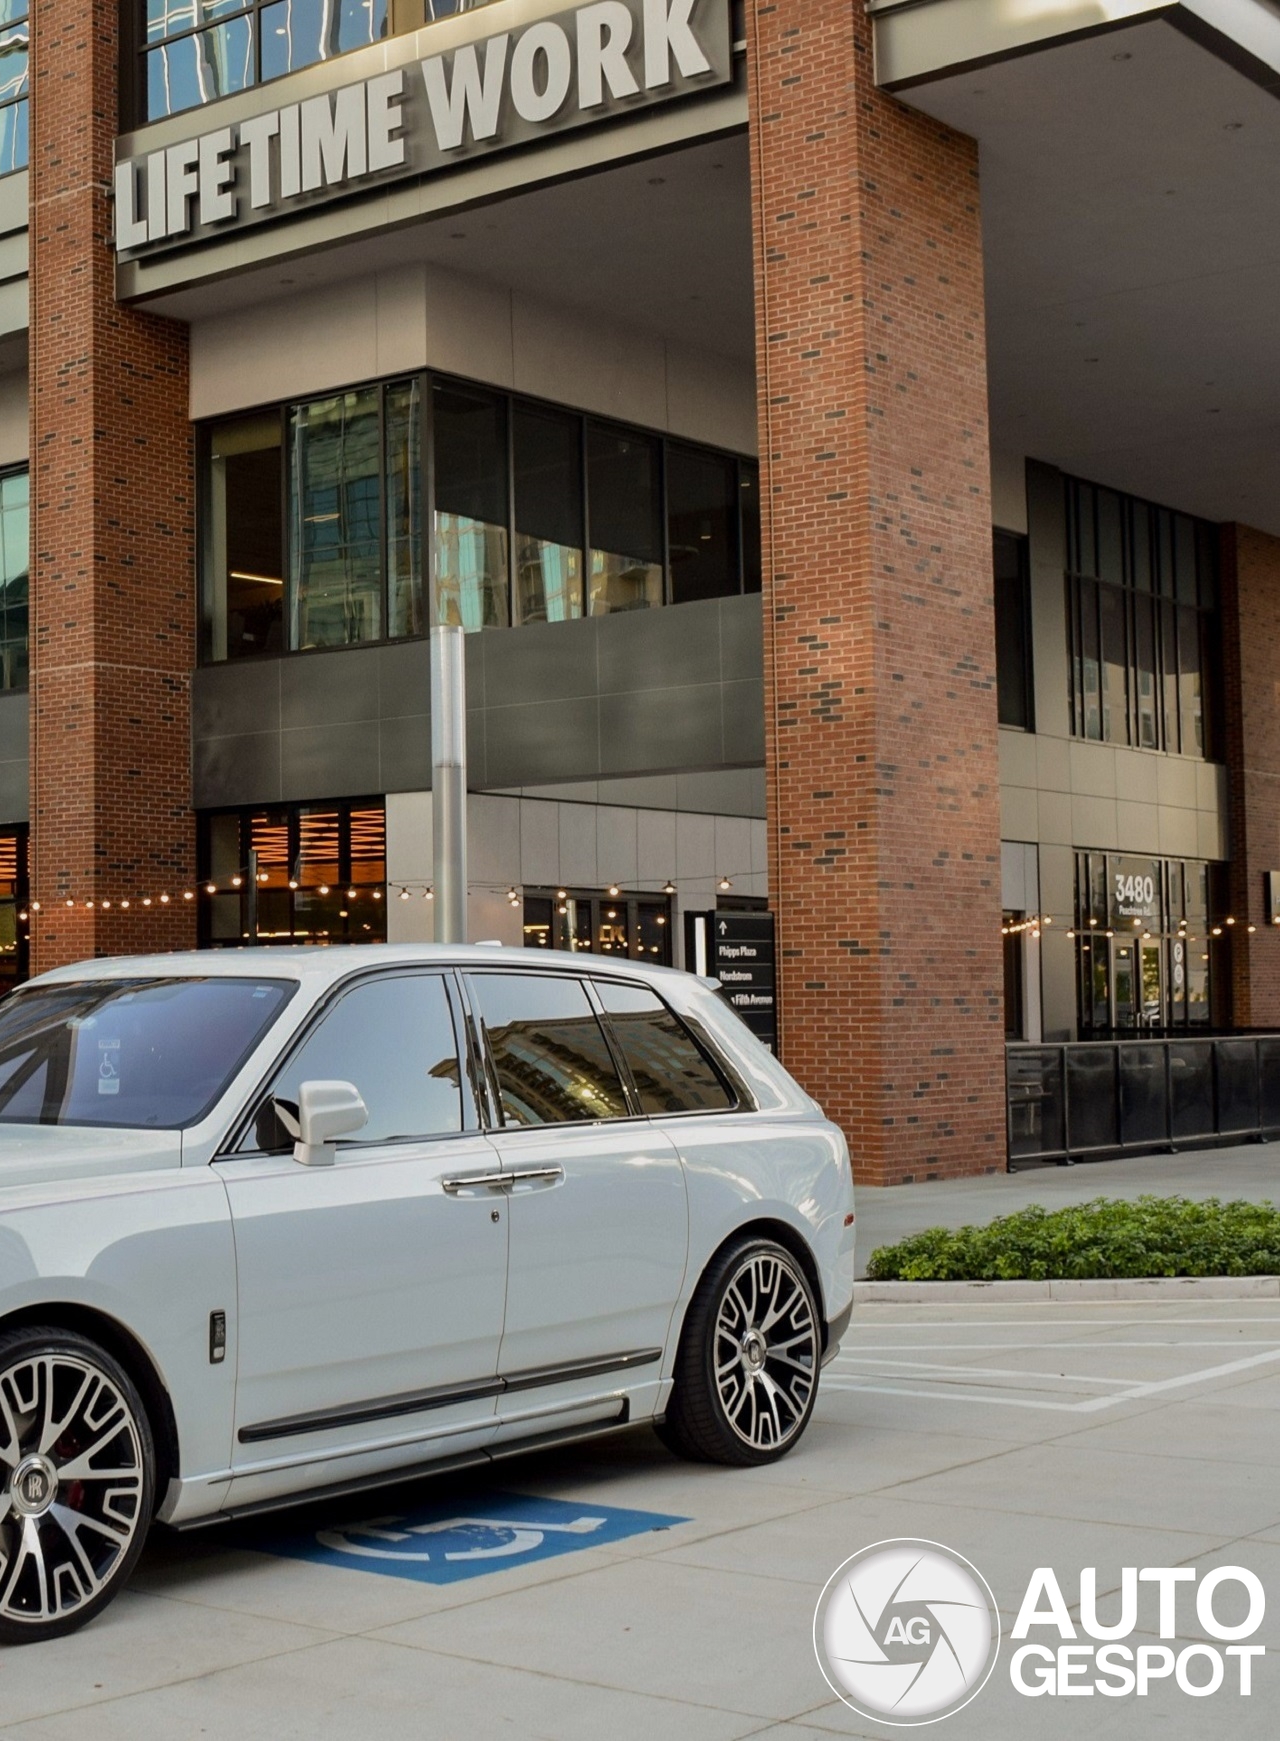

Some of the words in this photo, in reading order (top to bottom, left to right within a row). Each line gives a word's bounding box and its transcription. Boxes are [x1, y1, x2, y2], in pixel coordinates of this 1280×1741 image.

[421, 0, 712, 151] WORK
[1115, 874, 1154, 904] 3480
[1119, 904, 1143, 916] Peachtree
[719, 945, 740, 959] Phipps
[740, 945, 757, 957] Plaza
[719, 970, 753, 981] Nordstrom
[735, 994, 750, 1006] Fifth
[750, 994, 773, 1006] Avenue
